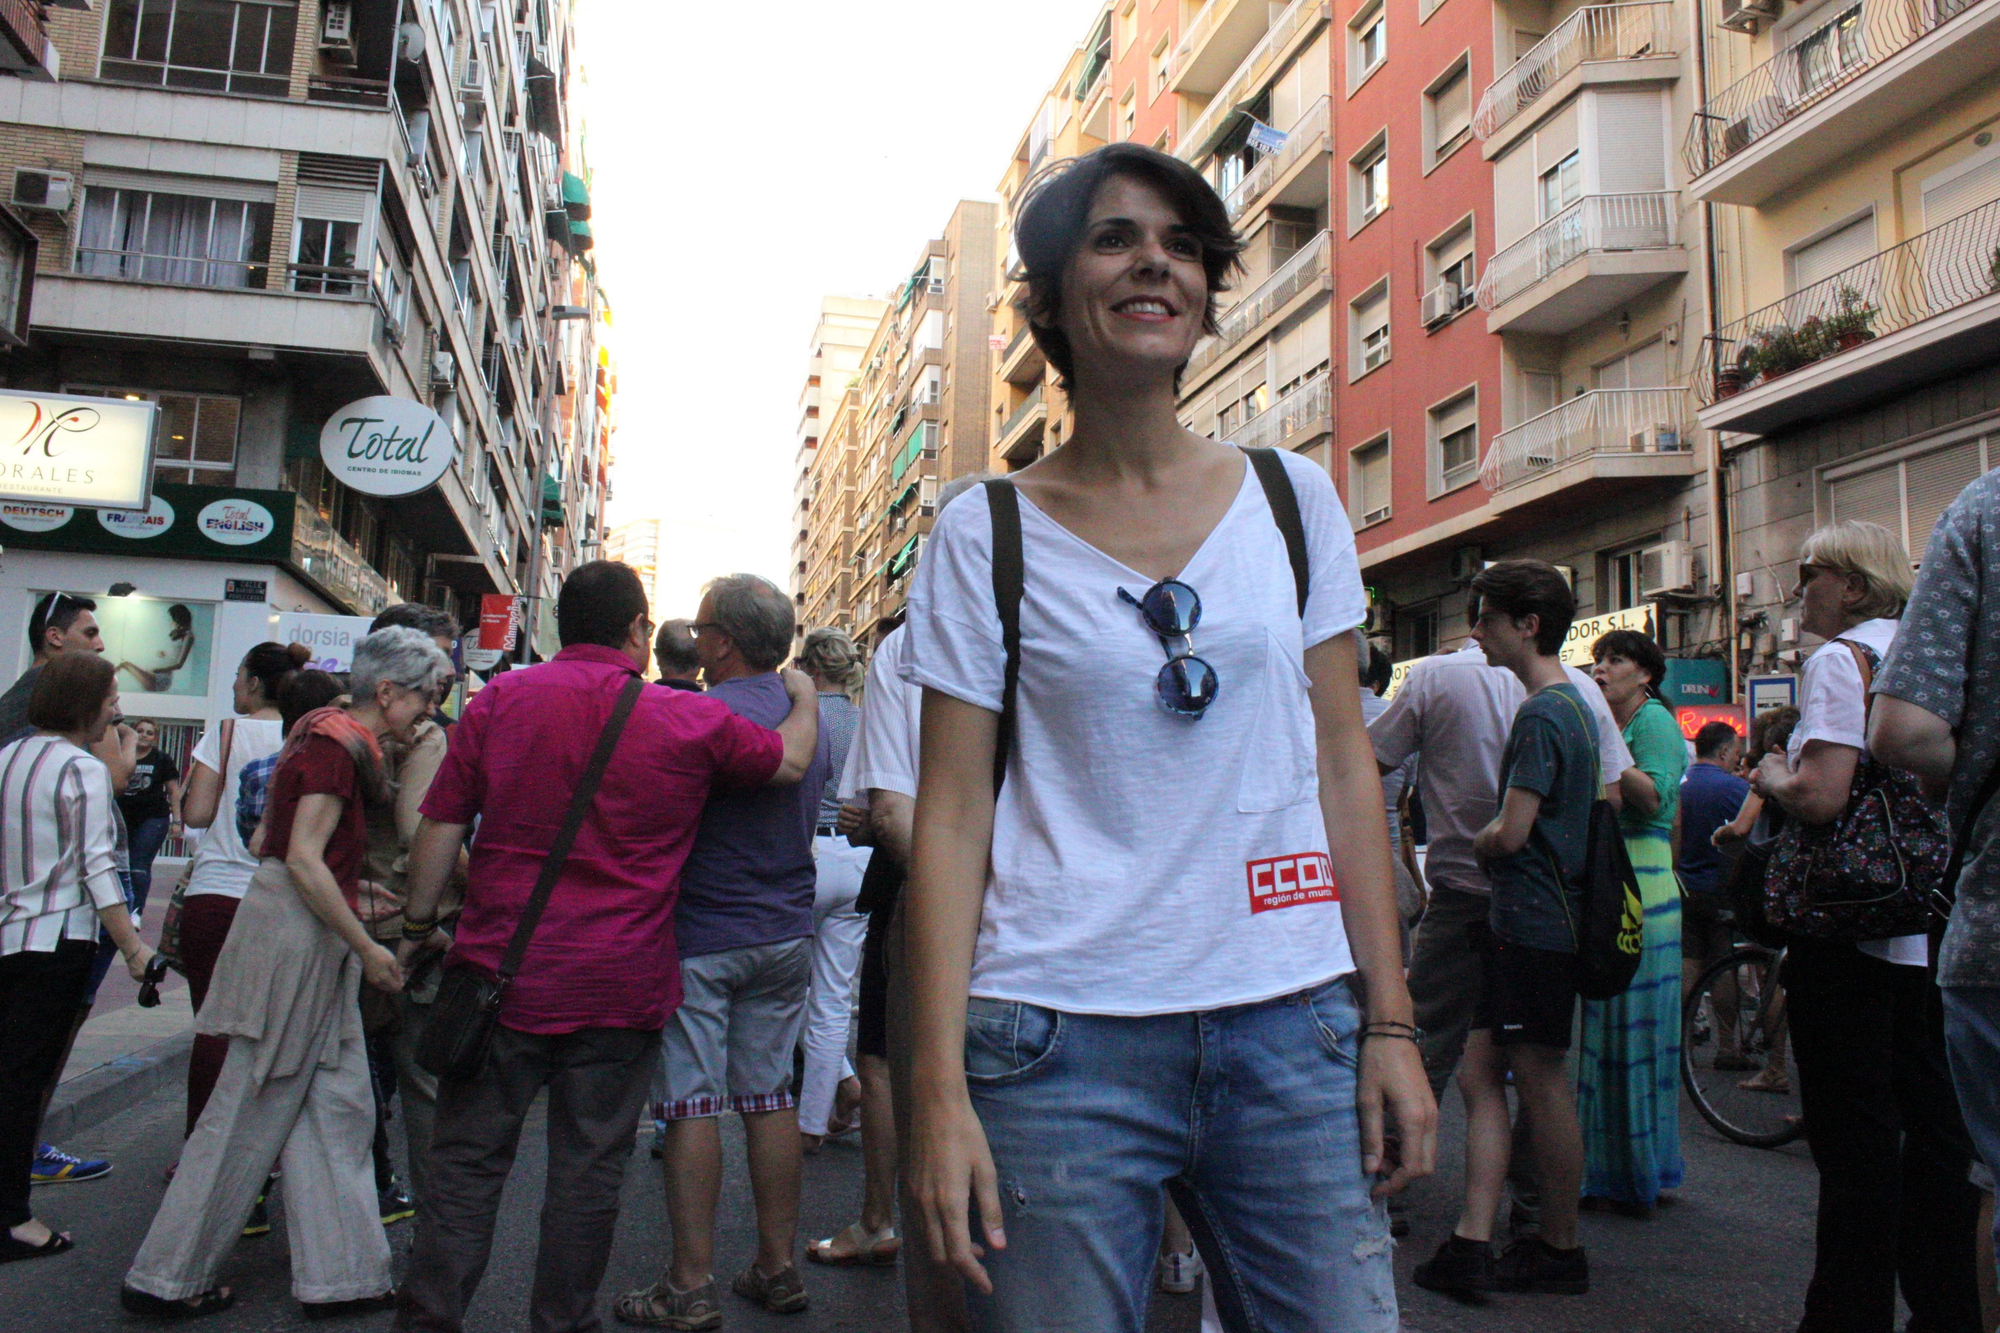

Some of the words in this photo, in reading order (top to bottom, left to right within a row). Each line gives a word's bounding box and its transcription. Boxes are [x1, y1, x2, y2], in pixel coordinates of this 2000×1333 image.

[339, 417, 435, 463] Total
[3, 505, 65, 518] DEUTSCH
[222, 505, 251, 520] Total
[206, 518, 264, 532] ENGLISH
[289, 623, 350, 646] dorsia
[1251, 856, 1335, 897] CCOO
[1263, 892, 1292, 906] región
[1293, 891, 1305, 900] de
